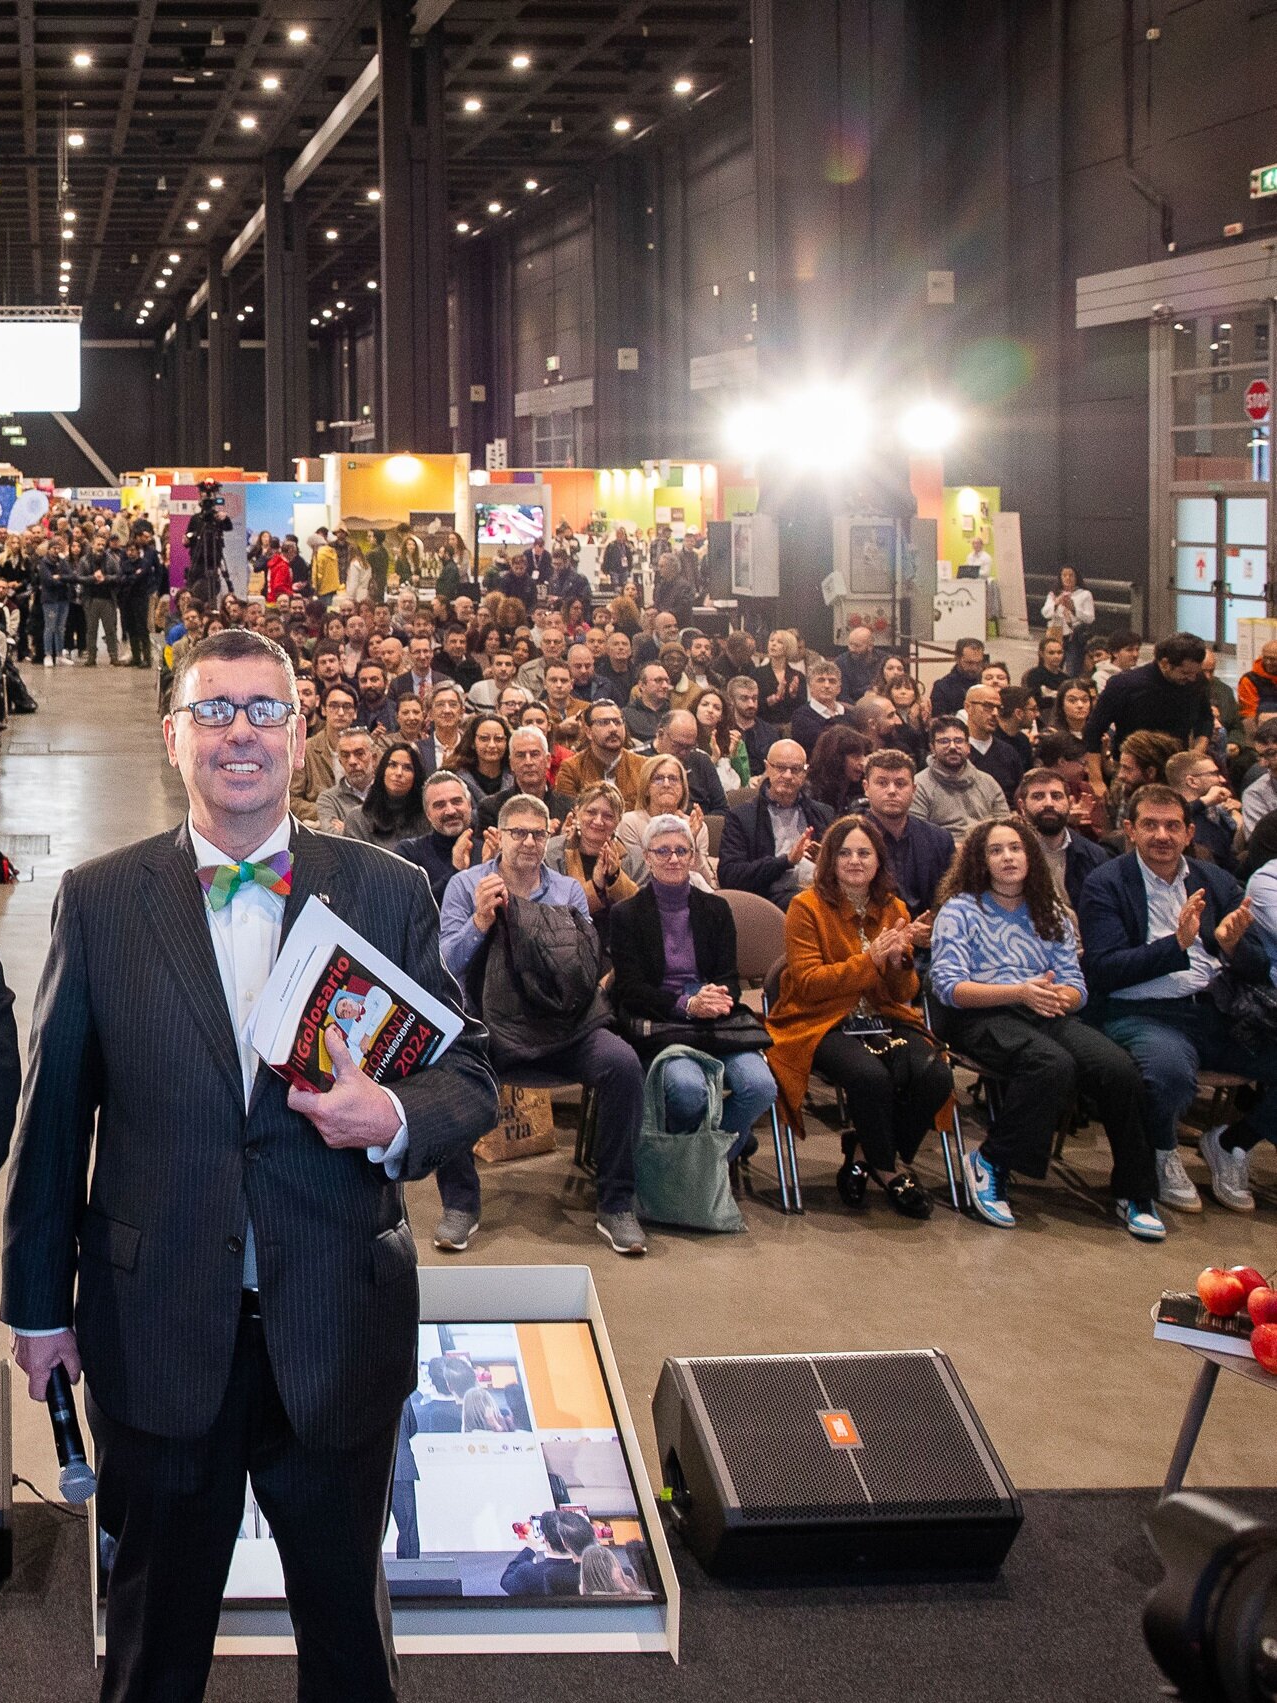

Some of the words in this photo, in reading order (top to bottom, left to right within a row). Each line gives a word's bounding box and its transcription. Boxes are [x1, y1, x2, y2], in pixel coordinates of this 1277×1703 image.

[1248, 392, 1270, 409] STOP
[380, 1012, 417, 1068] MASSOBRIO
[393, 1023, 432, 1078] 2024
